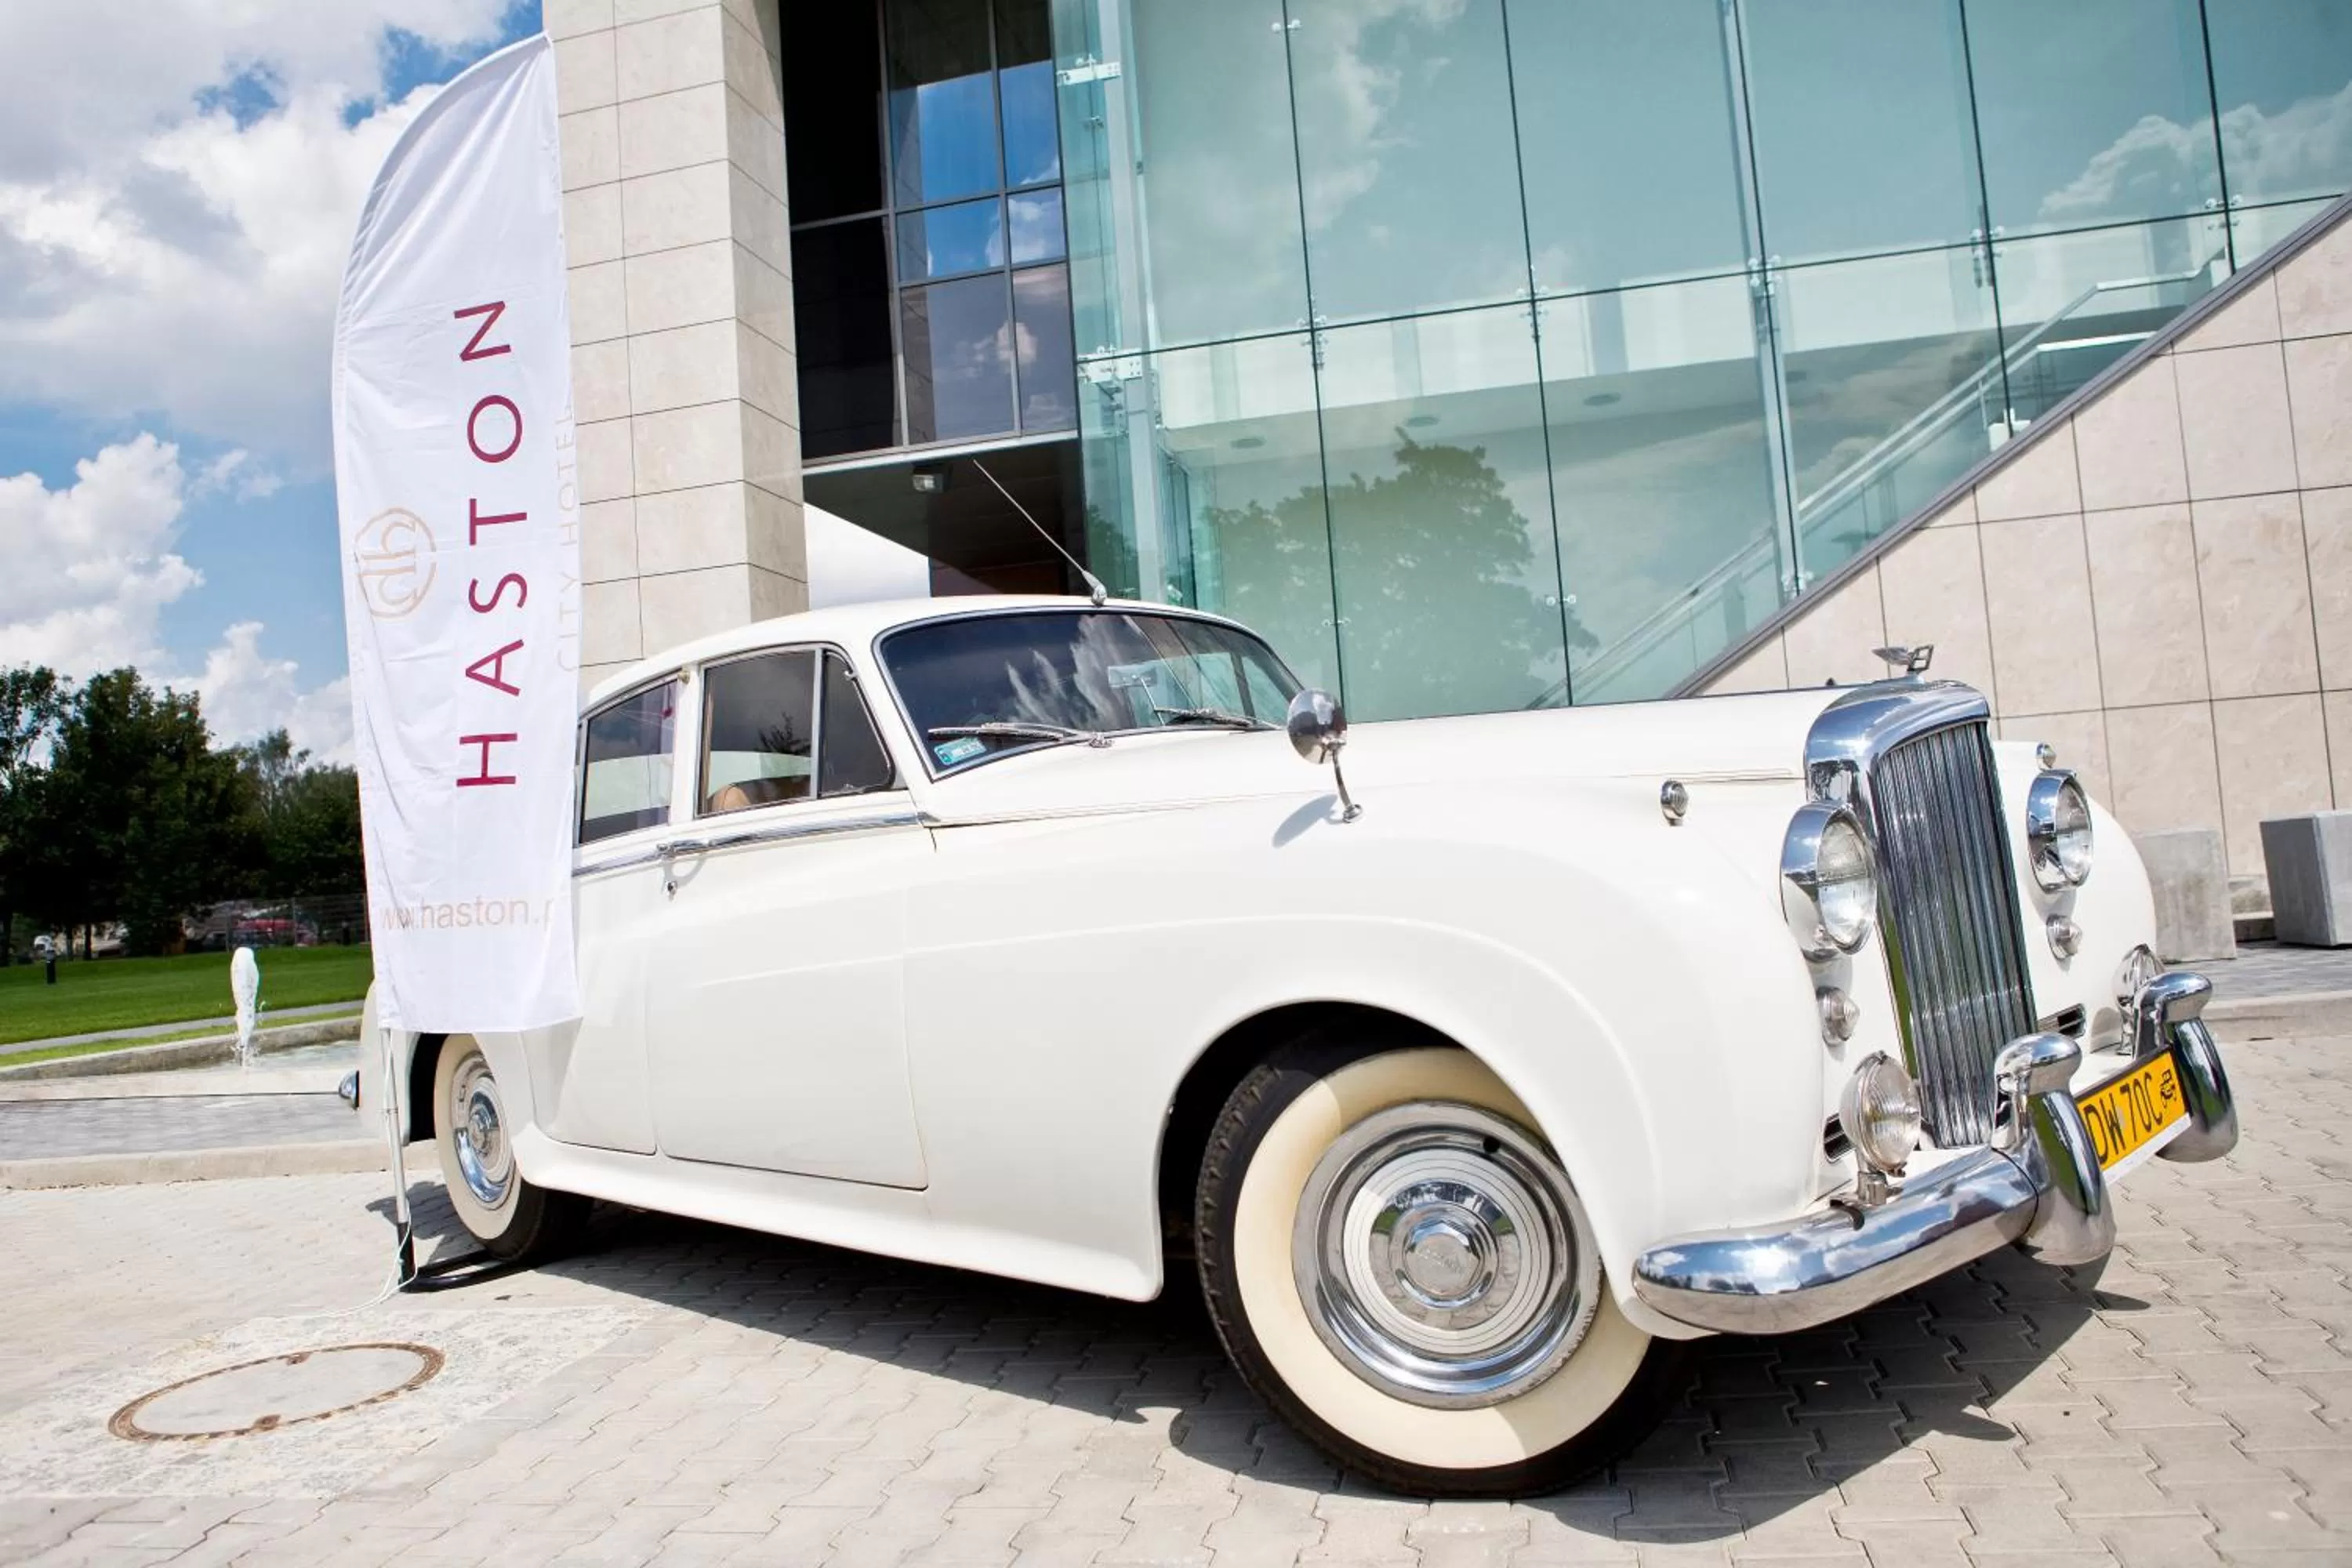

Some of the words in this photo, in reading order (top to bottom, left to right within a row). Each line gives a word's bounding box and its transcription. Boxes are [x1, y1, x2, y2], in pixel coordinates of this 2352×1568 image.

[455, 300, 527, 786] HASTON
[555, 405, 579, 546] HOTEL
[2082, 1091, 2127, 1165] DW
